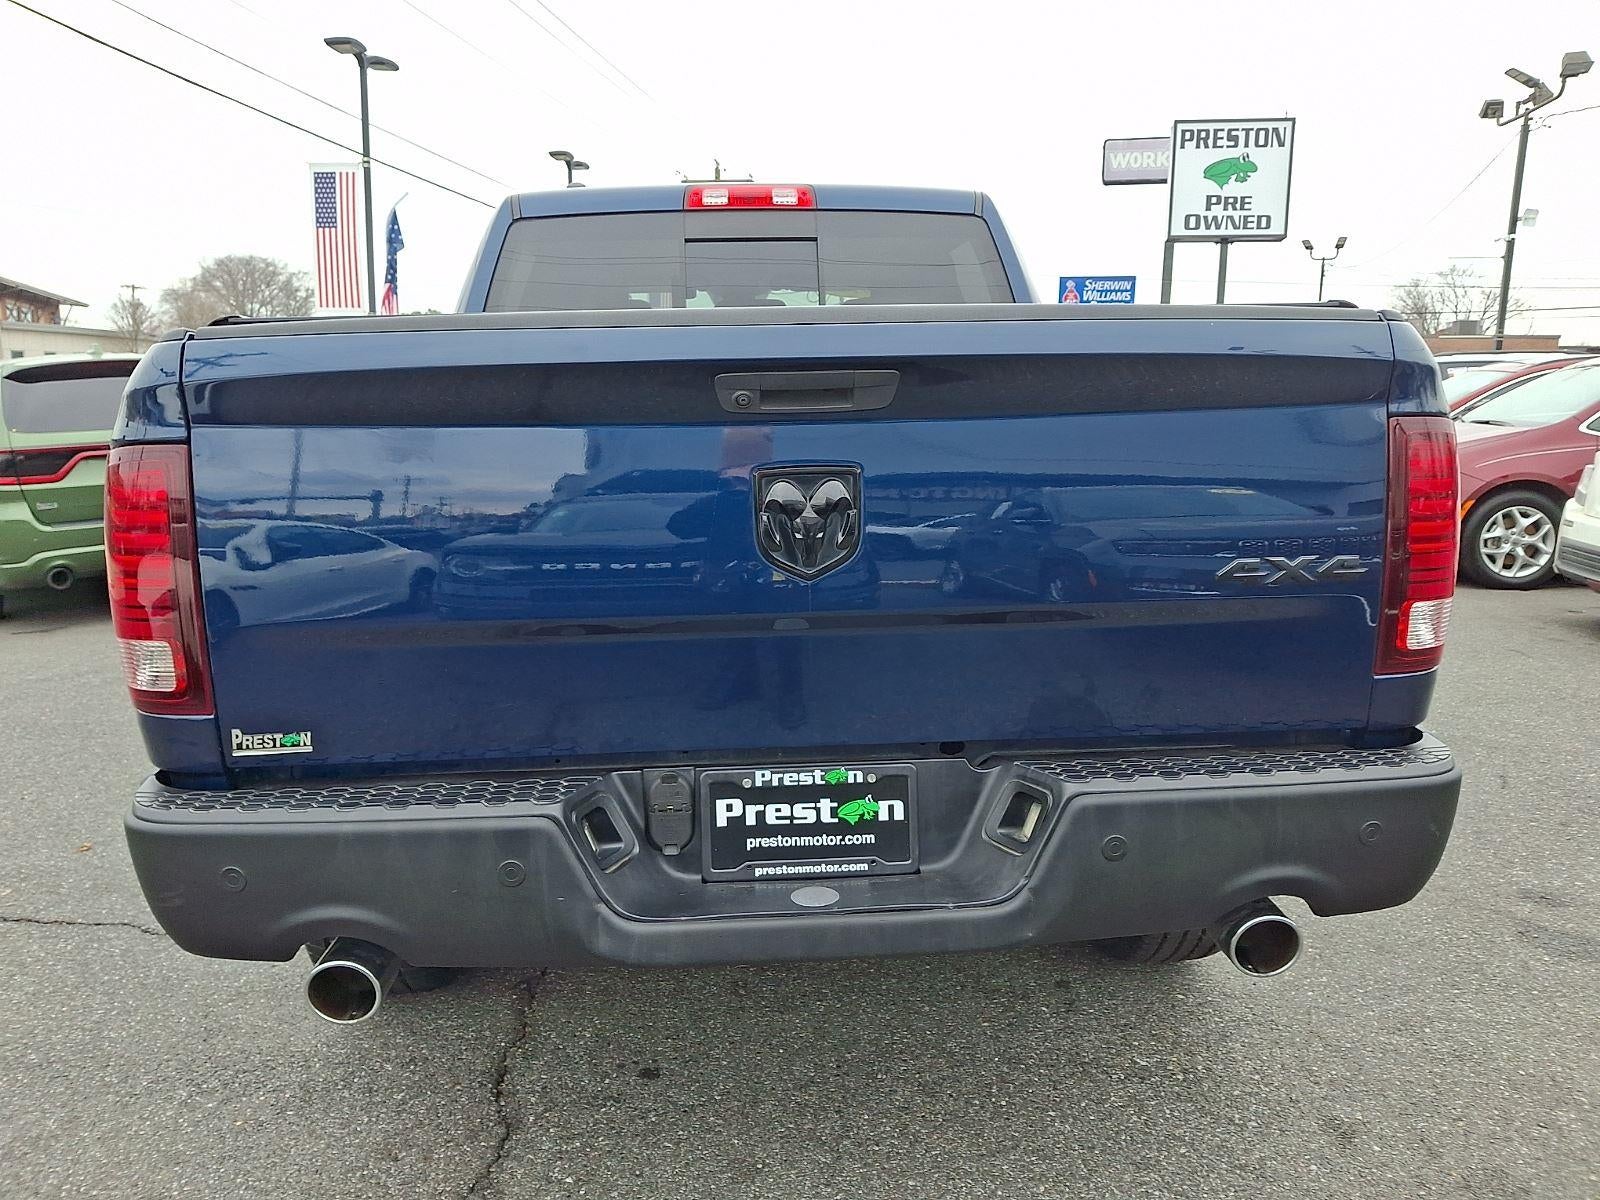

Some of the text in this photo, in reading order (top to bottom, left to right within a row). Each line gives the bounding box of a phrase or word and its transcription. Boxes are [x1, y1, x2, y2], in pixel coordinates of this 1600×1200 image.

[1180, 127, 1286, 149] PRESTON
[1109, 151, 1169, 169] WORK
[1205, 195, 1252, 211] PRE
[1184, 214, 1271, 230] OWNED
[1084, 280, 1132, 290] SHERWIN
[1082, 291, 1131, 301] WILLIAMS
[746, 833, 876, 851] prestonmotor.com
[754, 862, 869, 877] prestonmotor.com
